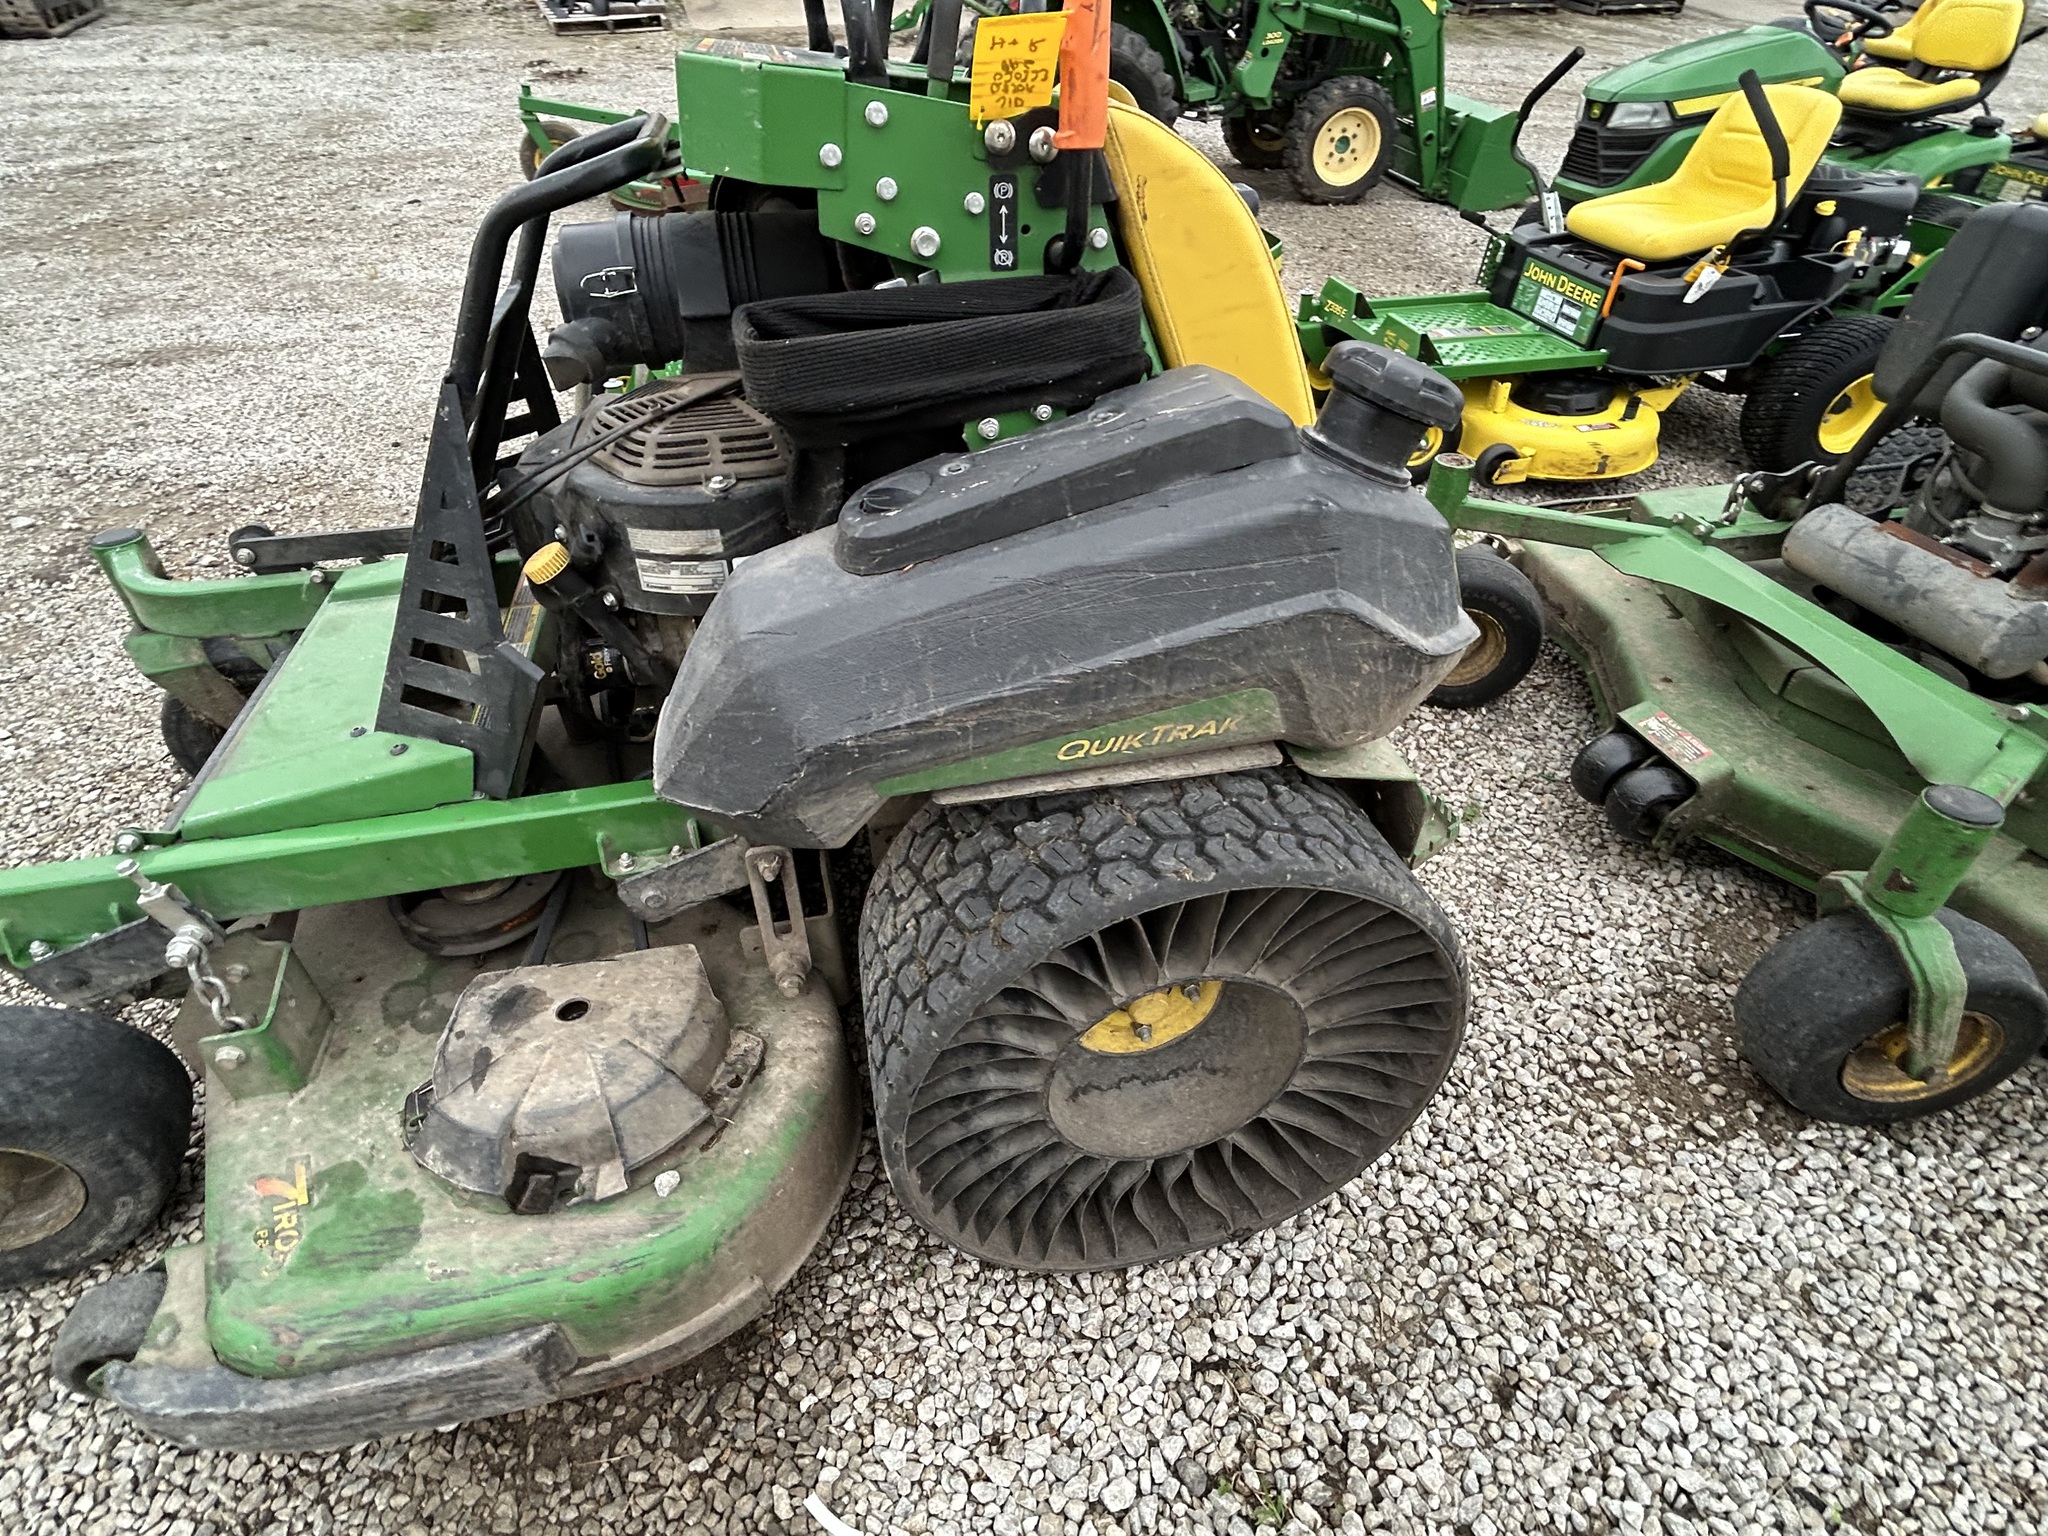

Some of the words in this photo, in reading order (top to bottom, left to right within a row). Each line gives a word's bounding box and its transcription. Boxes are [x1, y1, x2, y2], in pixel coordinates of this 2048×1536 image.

[1523, 262, 1557, 288] JOHN
[1556, 275, 1602, 308] DEERE
[590, 651, 607, 679] Gold
